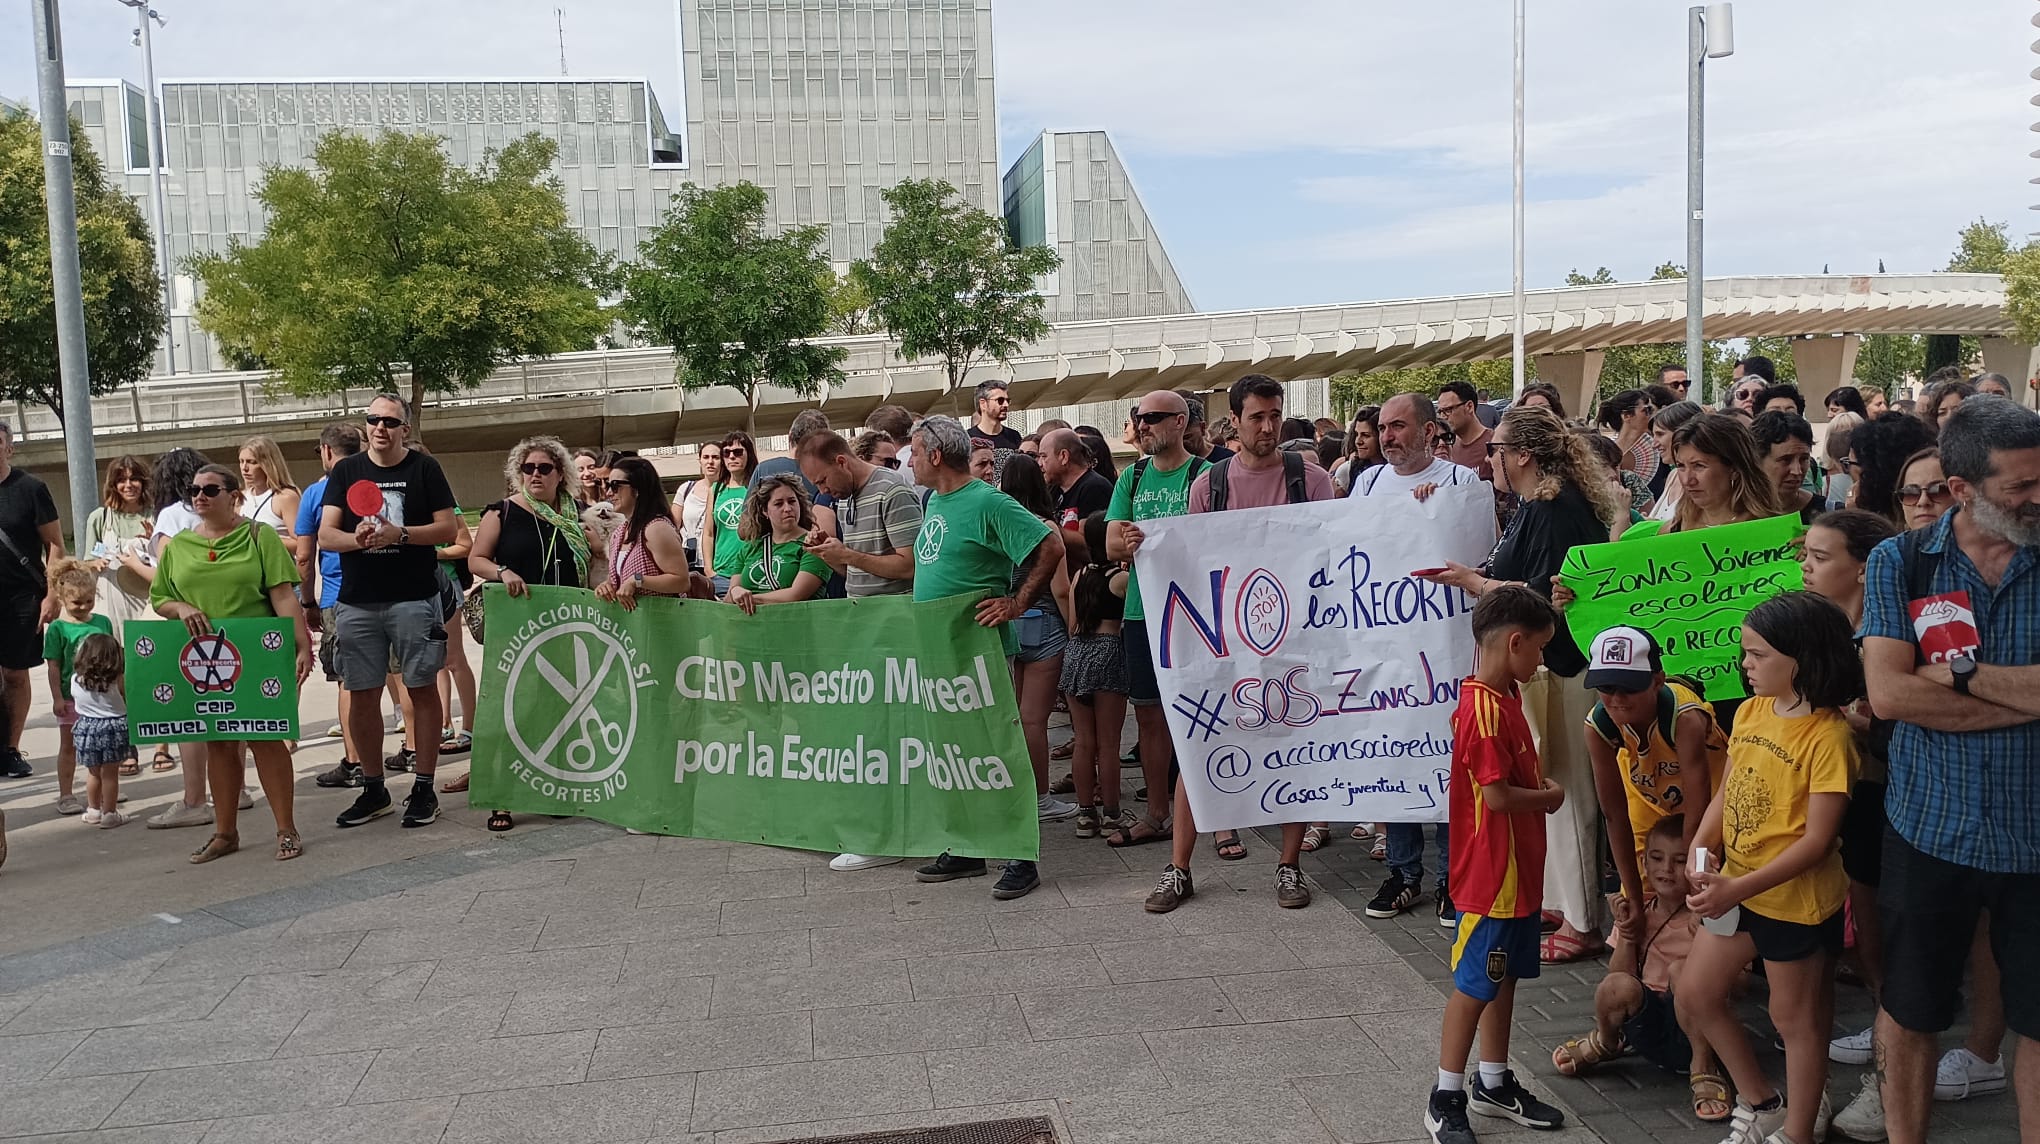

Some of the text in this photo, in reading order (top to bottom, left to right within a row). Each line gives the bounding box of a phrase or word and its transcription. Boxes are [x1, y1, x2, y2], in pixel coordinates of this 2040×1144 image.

[1133, 490, 1162, 505] SCUELA
[1700, 542, 1795, 577] Jóvene
[1251, 593, 1280, 625] STOP
[1624, 572, 1788, 617] escolares
[1160, 565, 1334, 669] NO a
[1302, 599, 1348, 630] los
[497, 603, 660, 689] EDUCACIÓN PÚBLICA SÍ
[1684, 625, 1743, 654] RECO
[1930, 645, 1977, 664] CGT
[212, 659, 241, 667] recortes
[675, 656, 746, 702] CEIP
[752, 661, 875, 704] Maestro
[1683, 655, 1743, 681] servi
[674, 739, 742, 784] por
[746, 730, 774, 778] la
[781, 734, 889, 785] Escuela
[508, 759, 628, 803] RECORTES NO
[1331, 777, 1345, 789] de
[1341, 776, 1412, 807] juventud
[1404, 783, 1436, 810] y
[1432, 767, 1450, 794] P
